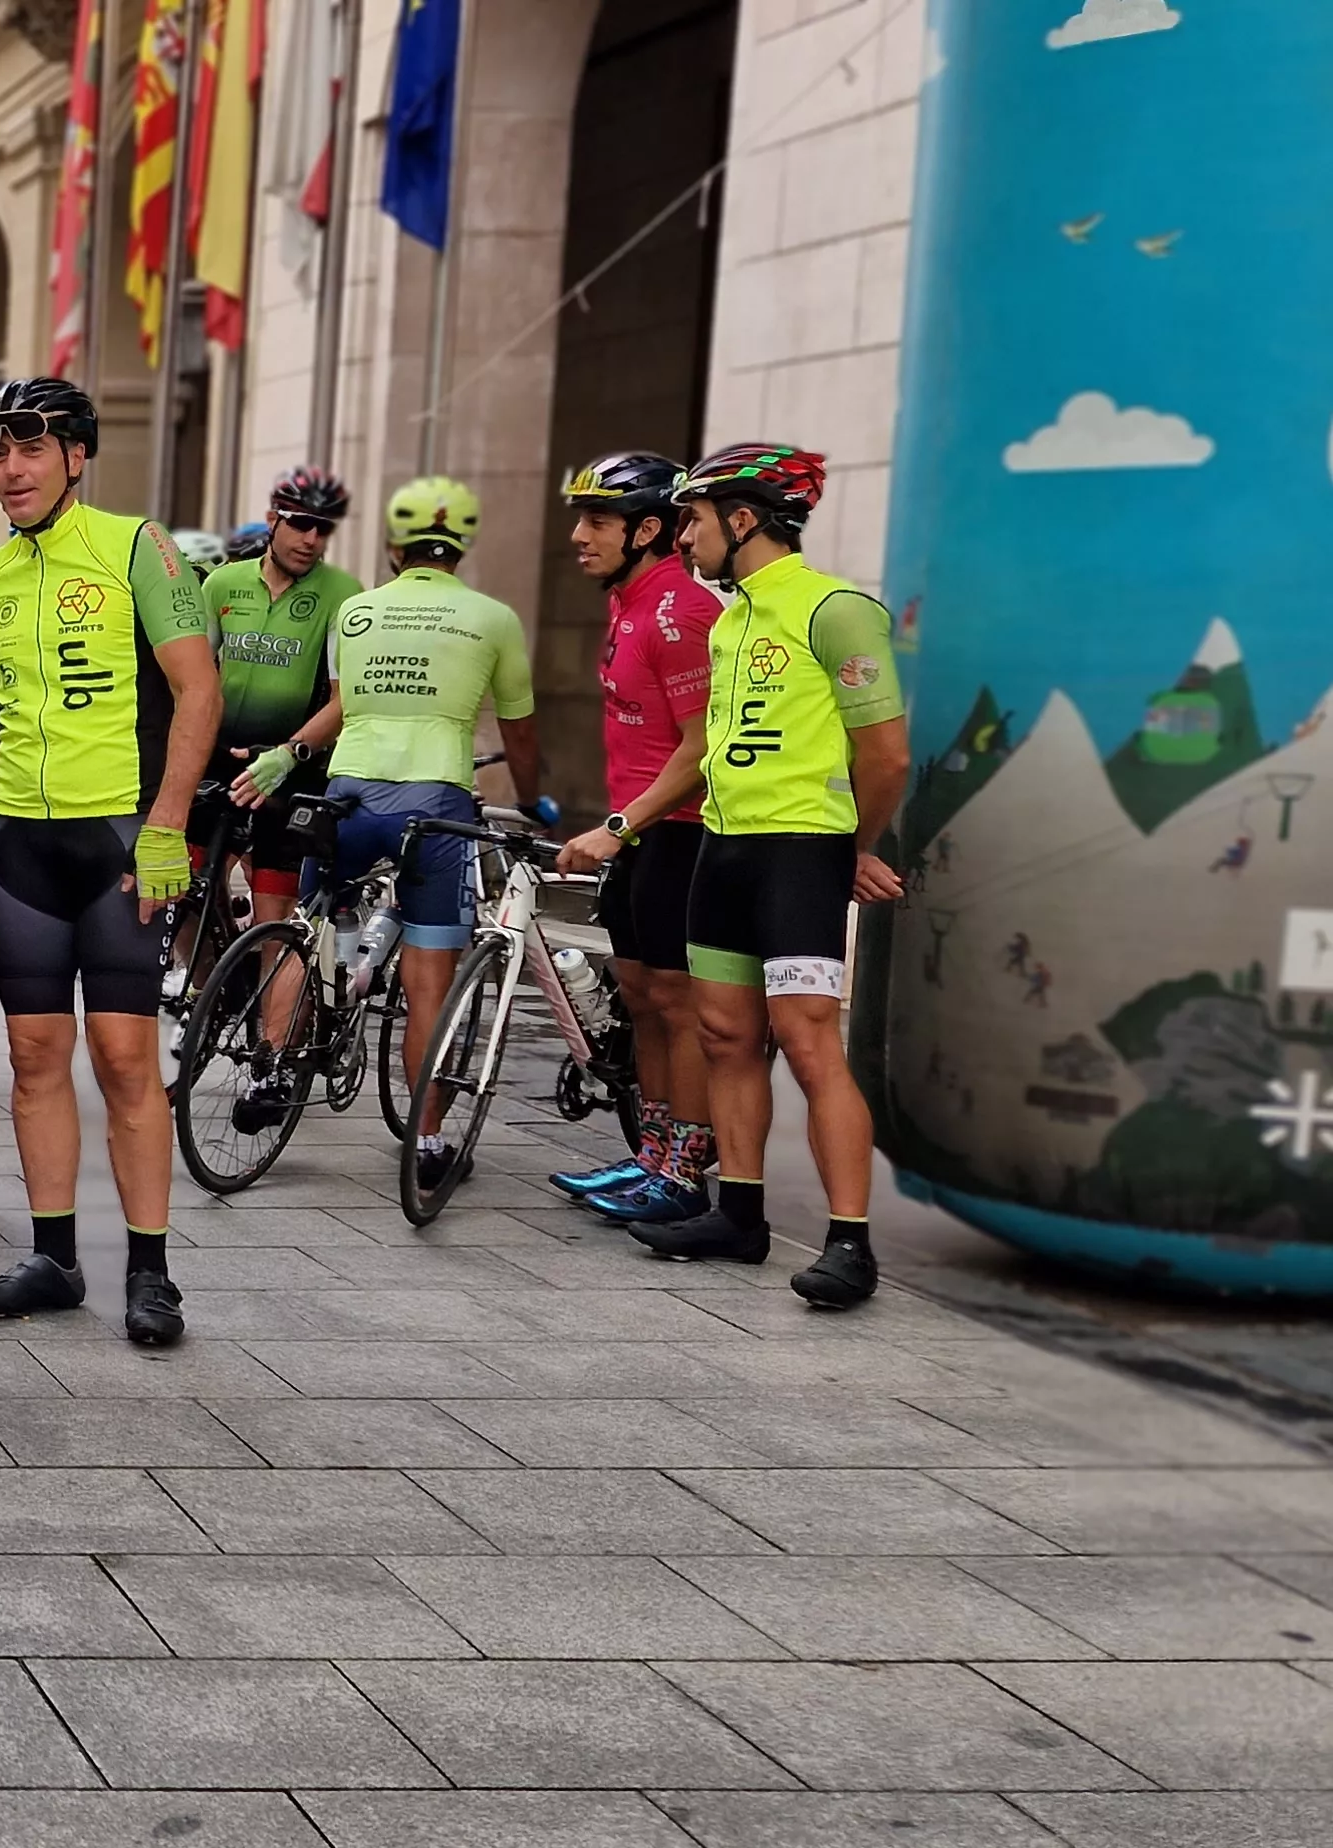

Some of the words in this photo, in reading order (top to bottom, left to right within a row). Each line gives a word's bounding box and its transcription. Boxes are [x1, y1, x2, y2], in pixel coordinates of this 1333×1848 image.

[385, 605, 456, 614] asociación
[383, 615, 442, 623] española
[58, 623, 104, 635] SPORTS
[381, 623, 421, 631] contra
[424, 623, 437, 631] el
[439, 625, 483, 642] cáncer
[365, 656, 430, 667] JUNTOS
[57, 640, 115, 710] ulb
[364, 670, 427, 681] CONTRA
[354, 685, 370, 695] EL
[374, 682, 438, 696] CÁNCER
[747, 685, 785, 693] SPORTS
[725, 700, 783, 768] ulb
